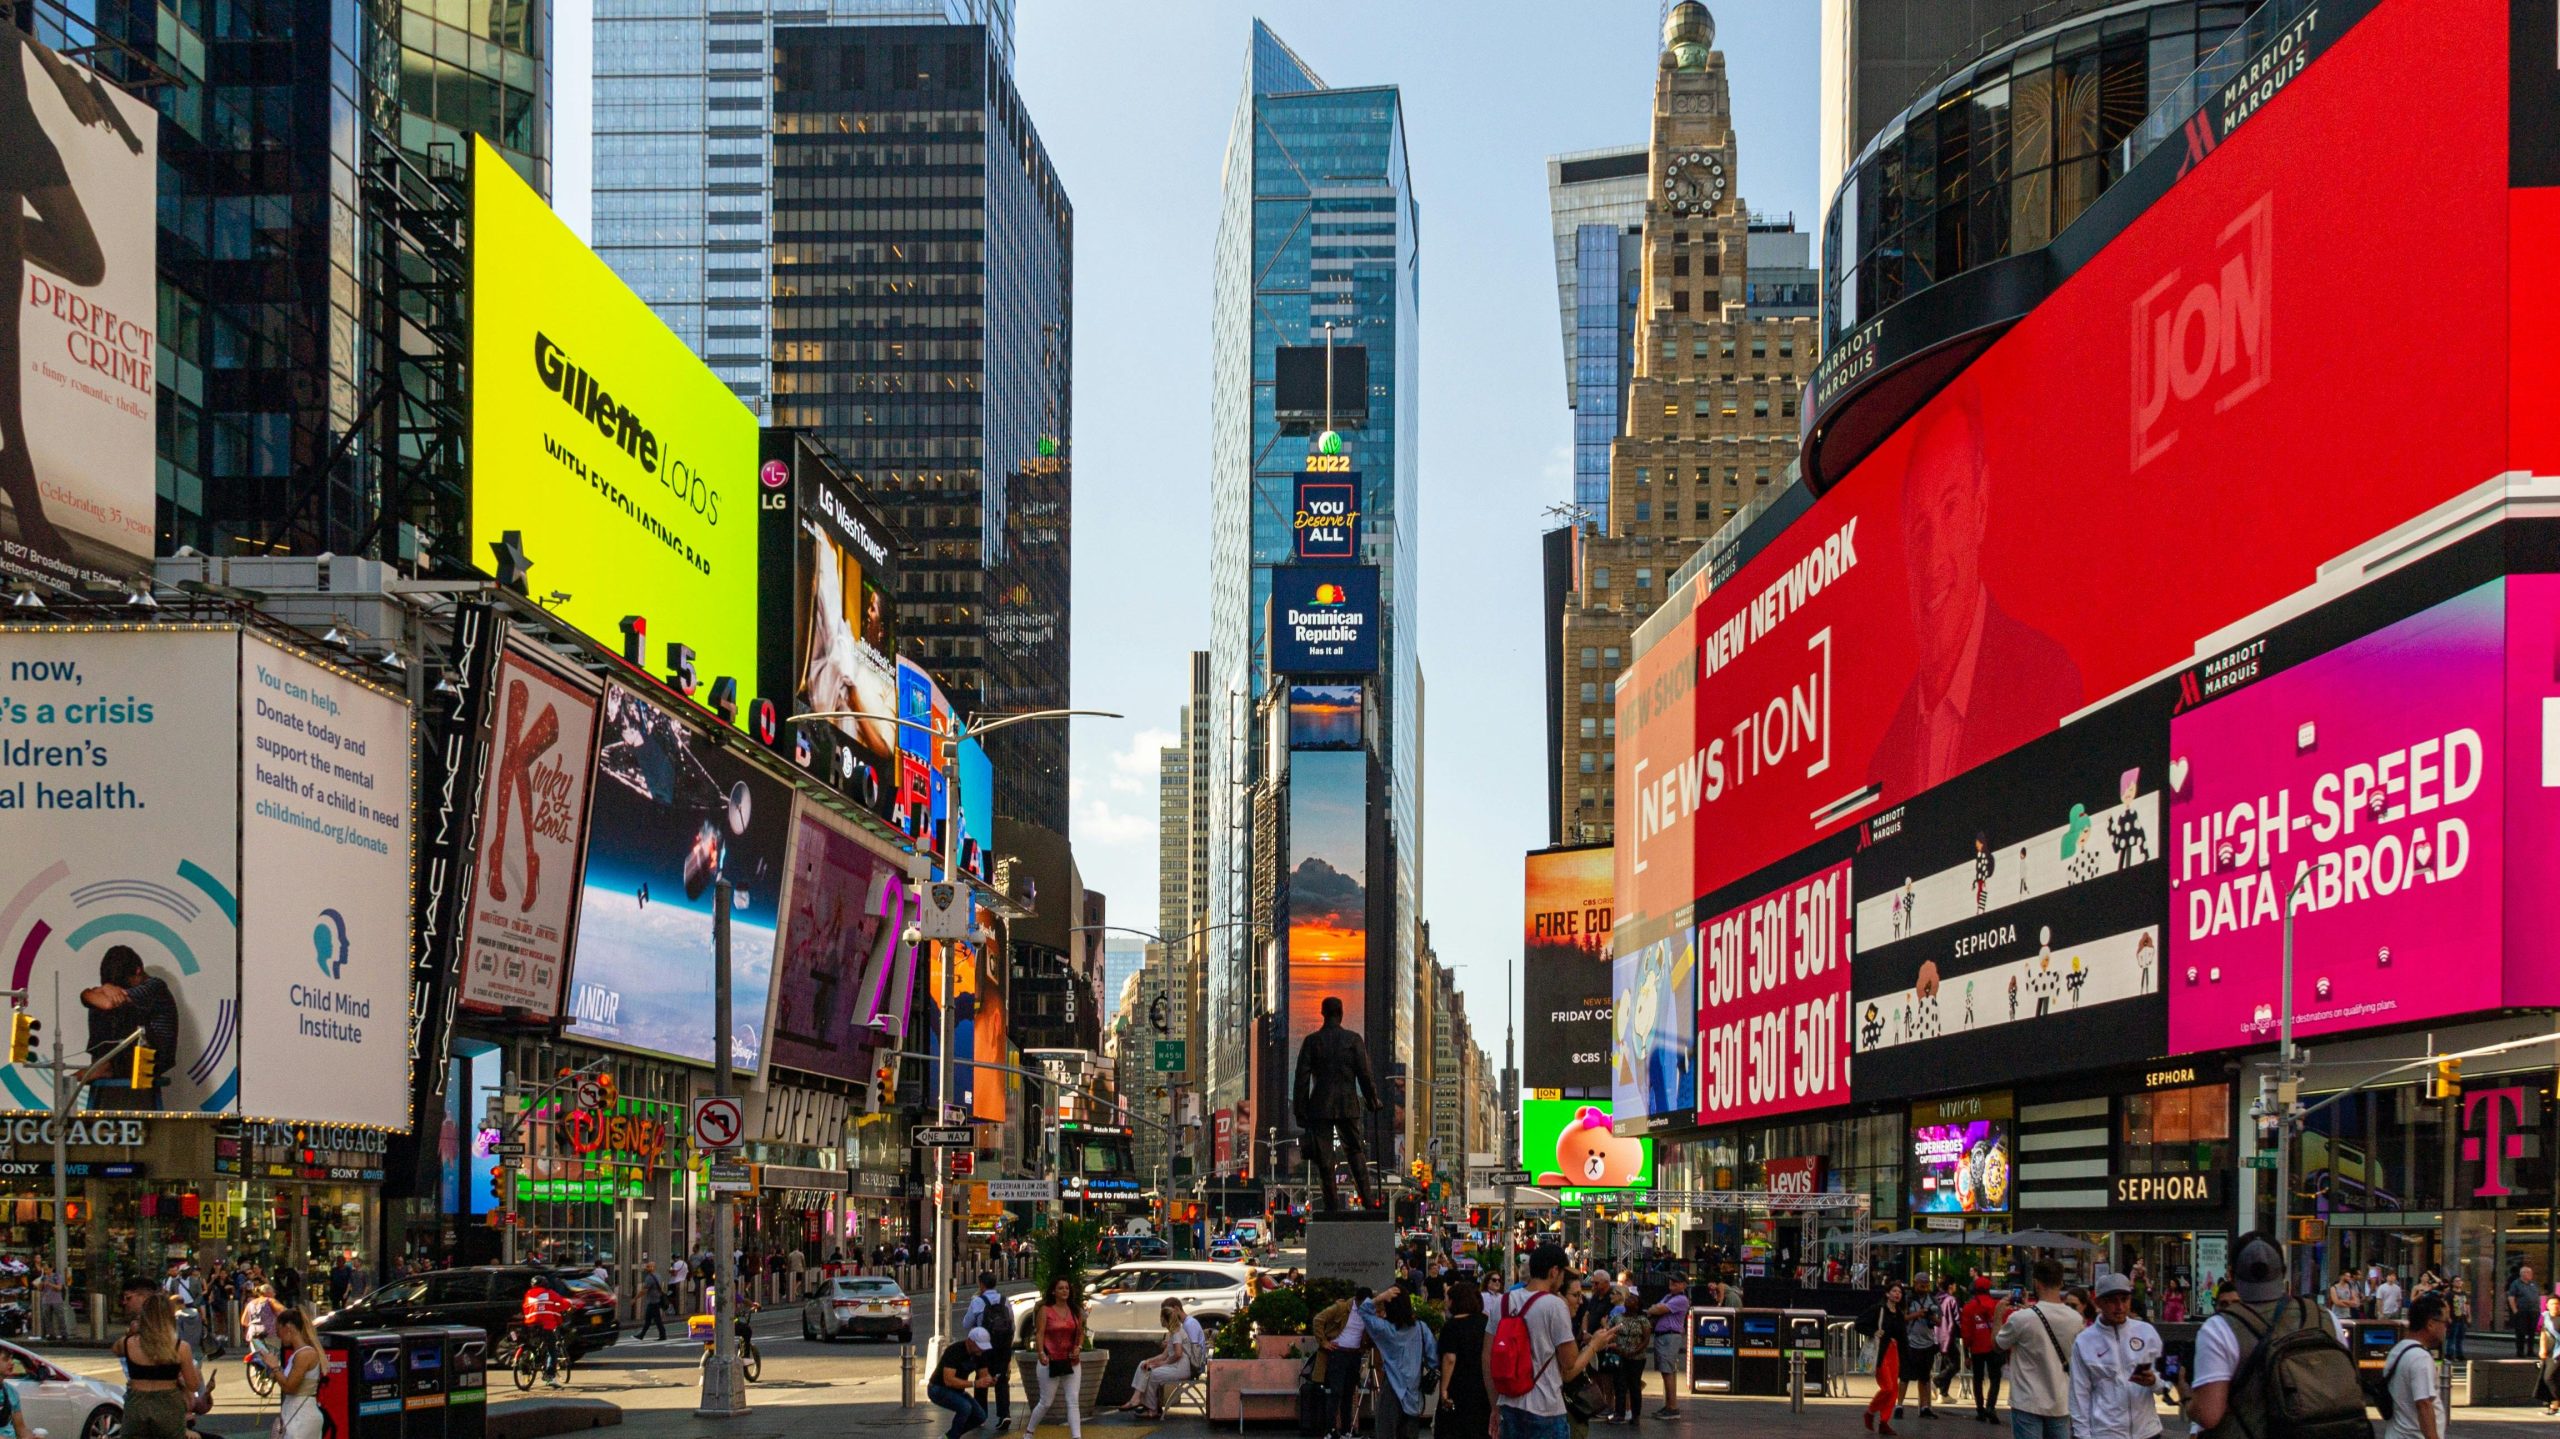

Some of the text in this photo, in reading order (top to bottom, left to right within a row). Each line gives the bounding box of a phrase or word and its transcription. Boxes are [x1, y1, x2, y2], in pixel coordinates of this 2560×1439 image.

[2224, 8, 2319, 108] MARRIOTT
[2223, 49, 2306, 135] MARQUIS
[29, 273, 153, 361] PERFECT
[67, 331, 152, 397] CRIME
[1818, 319, 1884, 385] MARRIOTT
[31, 361, 148, 421] a funny romantic thriller
[1818, 350, 1874, 407] MARQUIS
[544, 432, 587, 480] WITH
[1306, 456, 1350, 472] 2022
[40, 480, 153, 536] Celebrating 35 years
[762, 494, 786, 510] LG
[1309, 501, 1344, 514] YOU
[818, 483, 889, 567] LG WashTower
[1294, 510, 1360, 530] Deserve it
[1309, 528, 1344, 542] ALL
[4, 540, 91, 581] 1627 Broadway at
[1708, 540, 1740, 577] MARRIOTT
[1708, 560, 1737, 594] MARQUIS
[1706, 515, 1858, 679] NEW NETWORK
[1288, 610, 1363, 625] Dominican
[1295, 626, 1357, 643] Republic
[1309, 647, 1324, 655] Has
[1333, 647, 1344, 655] all
[11, 660, 83, 686] now,
[2205, 639, 2267, 678] MARRIOTT
[256, 664, 342, 717] You can help.
[619, 615, 777, 746] 1540
[2205, 661, 2259, 695] MARQUIS
[36, 696, 154, 724] a crisis
[1619, 647, 1700, 743] NEW SHOW
[256, 698, 366, 756] Donate today and
[256, 735, 375, 791] support the mental
[36, 782, 145, 809] health.
[256, 764, 400, 829] health of a child in need
[2182, 727, 2484, 882] HIGH-SPEED
[256, 799, 389, 856] childmind.org/donate
[532, 805, 574, 845] Boots
[1873, 806, 1906, 830] MARRIOTT
[1873, 821, 1902, 843] MARQUIS
[2190, 816, 2470, 941] DATA ABROAD
[1535, 910, 1578, 938] FIRE
[1955, 924, 2017, 959] SEPHORA
[290, 984, 370, 1019] Child Mind
[576, 984, 620, 1025] ANDOR
[1065, 979, 1075, 1024] 1500
[1551, 1010, 1593, 1022] FRIDAY
[2240, 1023, 2249, 1033] Up
[2250, 1021, 2256, 1031] to
[2295, 1009, 2334, 1024] destinations
[2334, 1009, 2343, 1018] on
[2343, 1003, 2376, 1018] qualifying
[2377, 1000, 2398, 1011] plans.
[299, 1013, 362, 1043] Institute
[1581, 1053, 1600, 1063] CBS
[2146, 1068, 2195, 1087] SEPHORA
[762, 1083, 849, 1148] FOREVER
[1940, 1097, 1981, 1118] INVICTA
[308, 1125, 388, 1153] LUGGAGE
[921, 1131, 966, 1141] ONE WAY
[1915, 1139, 1963, 1156] SUPERHEROES
[269, 1164, 293, 1176] Nikon
[331, 1168, 359, 1179] SONY
[2258, 1158, 2268, 1167] 46
[870, 1172, 885, 1187] POLO
[2118, 1176, 2208, 1201] SEPHORA
[784, 1190, 821, 1210] FOREVER
[202, 1201, 226, 1233] ATM ATM
[1694, 1347, 1711, 1355] TIMES
[360, 1401, 400, 1413] TIMES SQUARE
[408, 1396, 445, 1407] TIMES SQUARE
